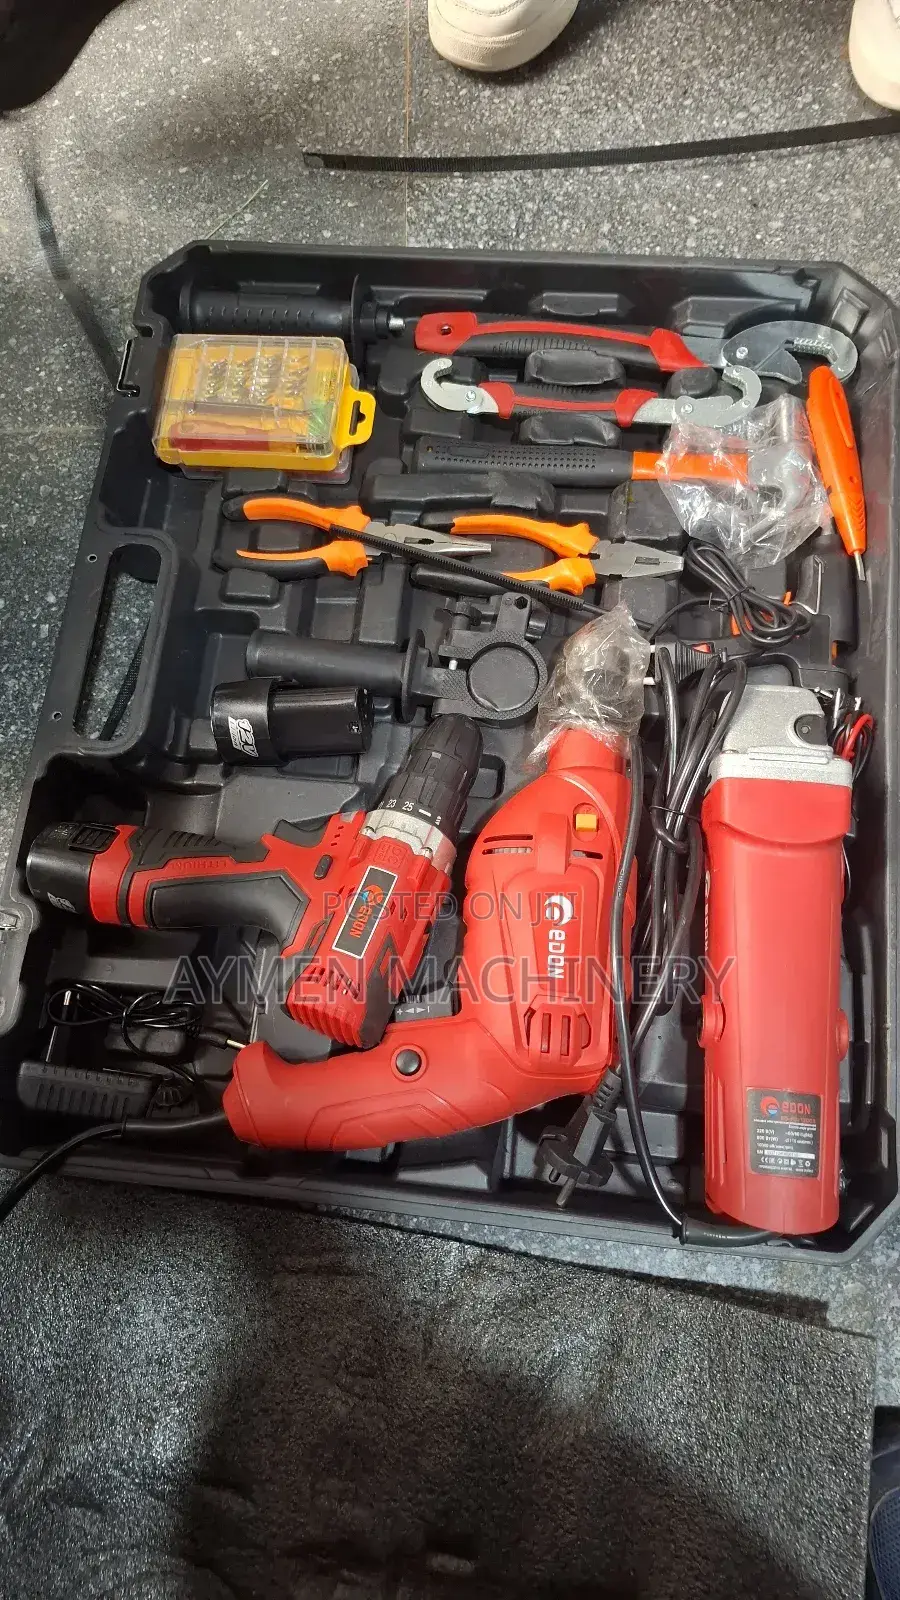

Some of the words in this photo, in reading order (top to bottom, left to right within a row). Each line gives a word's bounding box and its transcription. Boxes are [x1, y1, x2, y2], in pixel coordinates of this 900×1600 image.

[236, 718, 259, 757] 12V
[386, 799, 397, 808] 23
[402, 801, 415, 812] 25
